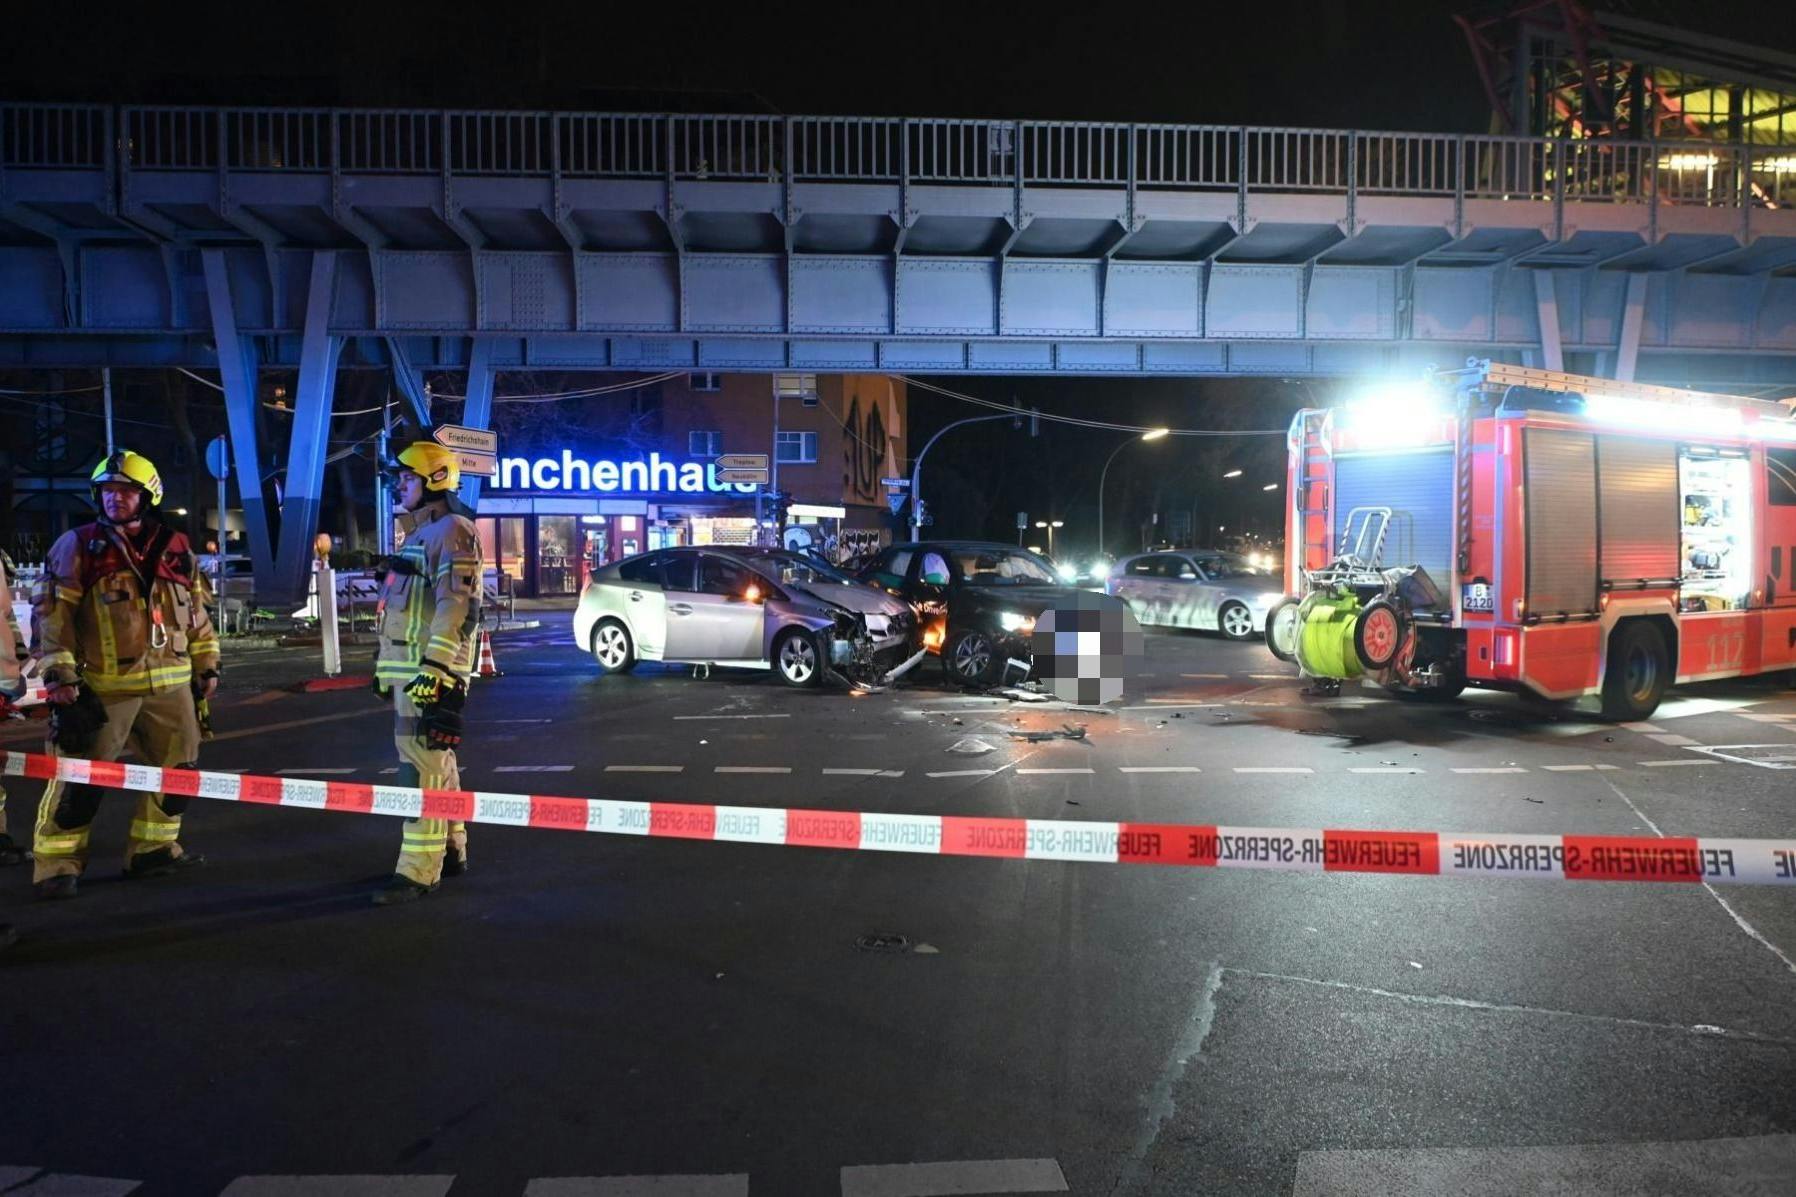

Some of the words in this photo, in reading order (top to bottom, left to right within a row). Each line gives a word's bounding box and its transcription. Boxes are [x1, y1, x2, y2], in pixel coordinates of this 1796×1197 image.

[448, 431, 489, 447] Friedrichshain
[462, 458, 476, 467] Mitte
[490, 449, 758, 493] nchenhau
